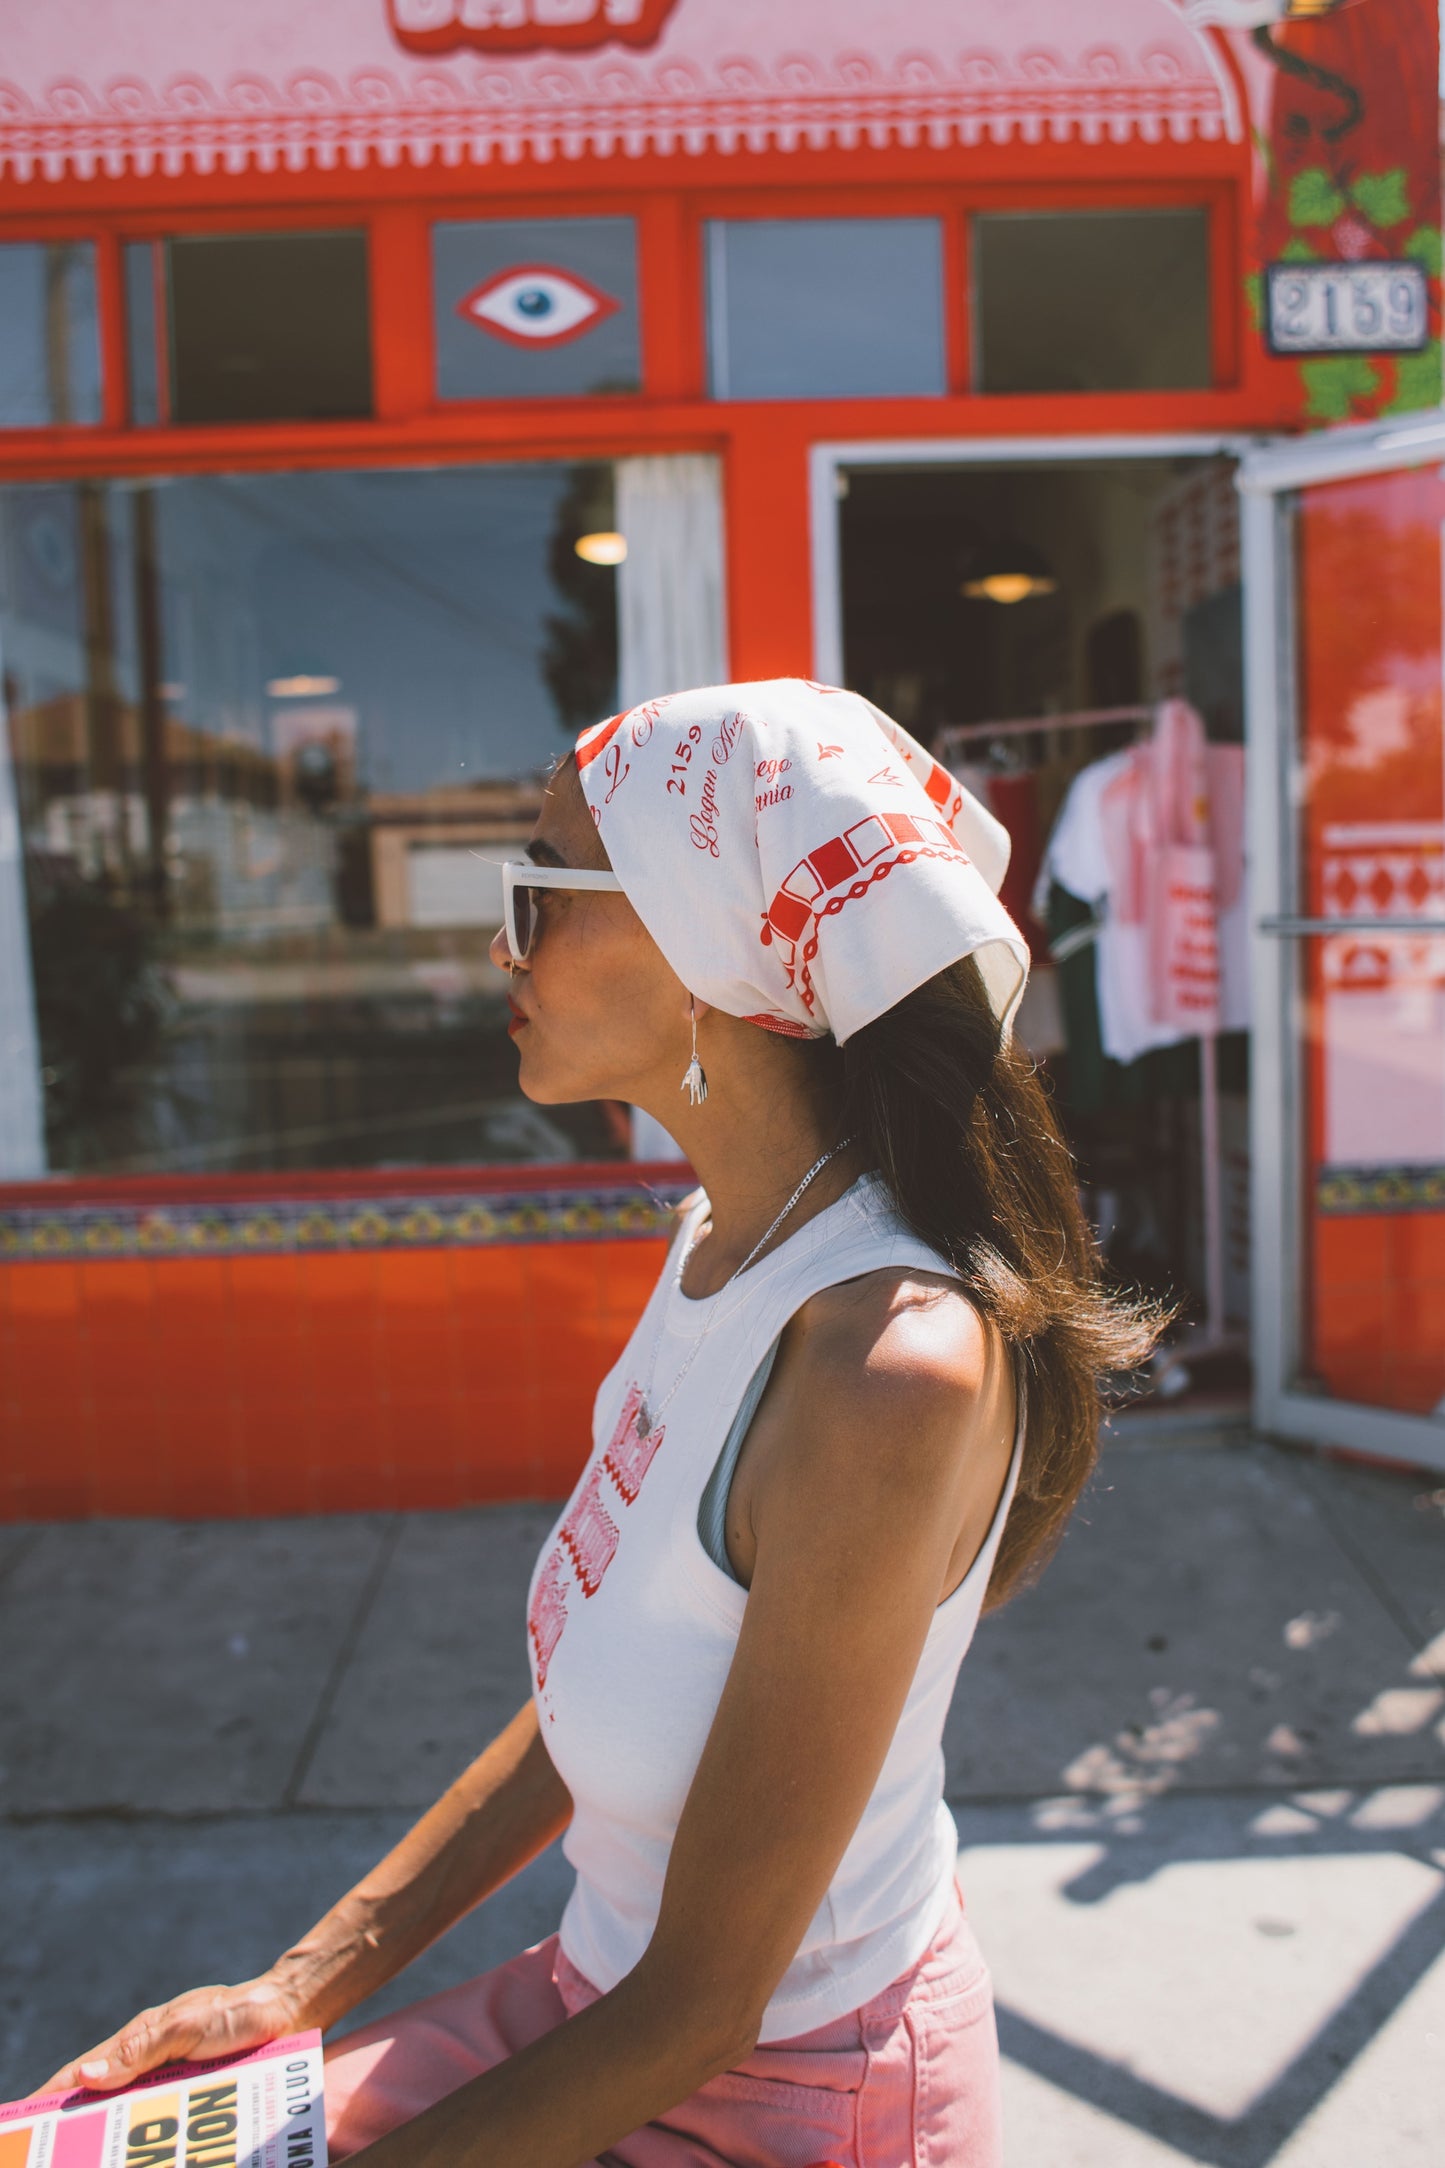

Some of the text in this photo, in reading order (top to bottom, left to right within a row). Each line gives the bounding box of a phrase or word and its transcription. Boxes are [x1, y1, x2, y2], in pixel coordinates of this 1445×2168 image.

[1275, 280, 1418, 336] 2159
[666, 725, 701, 796] 2159
[689, 769, 720, 858] Logan
[286, 2061, 311, 2115] OLUO
